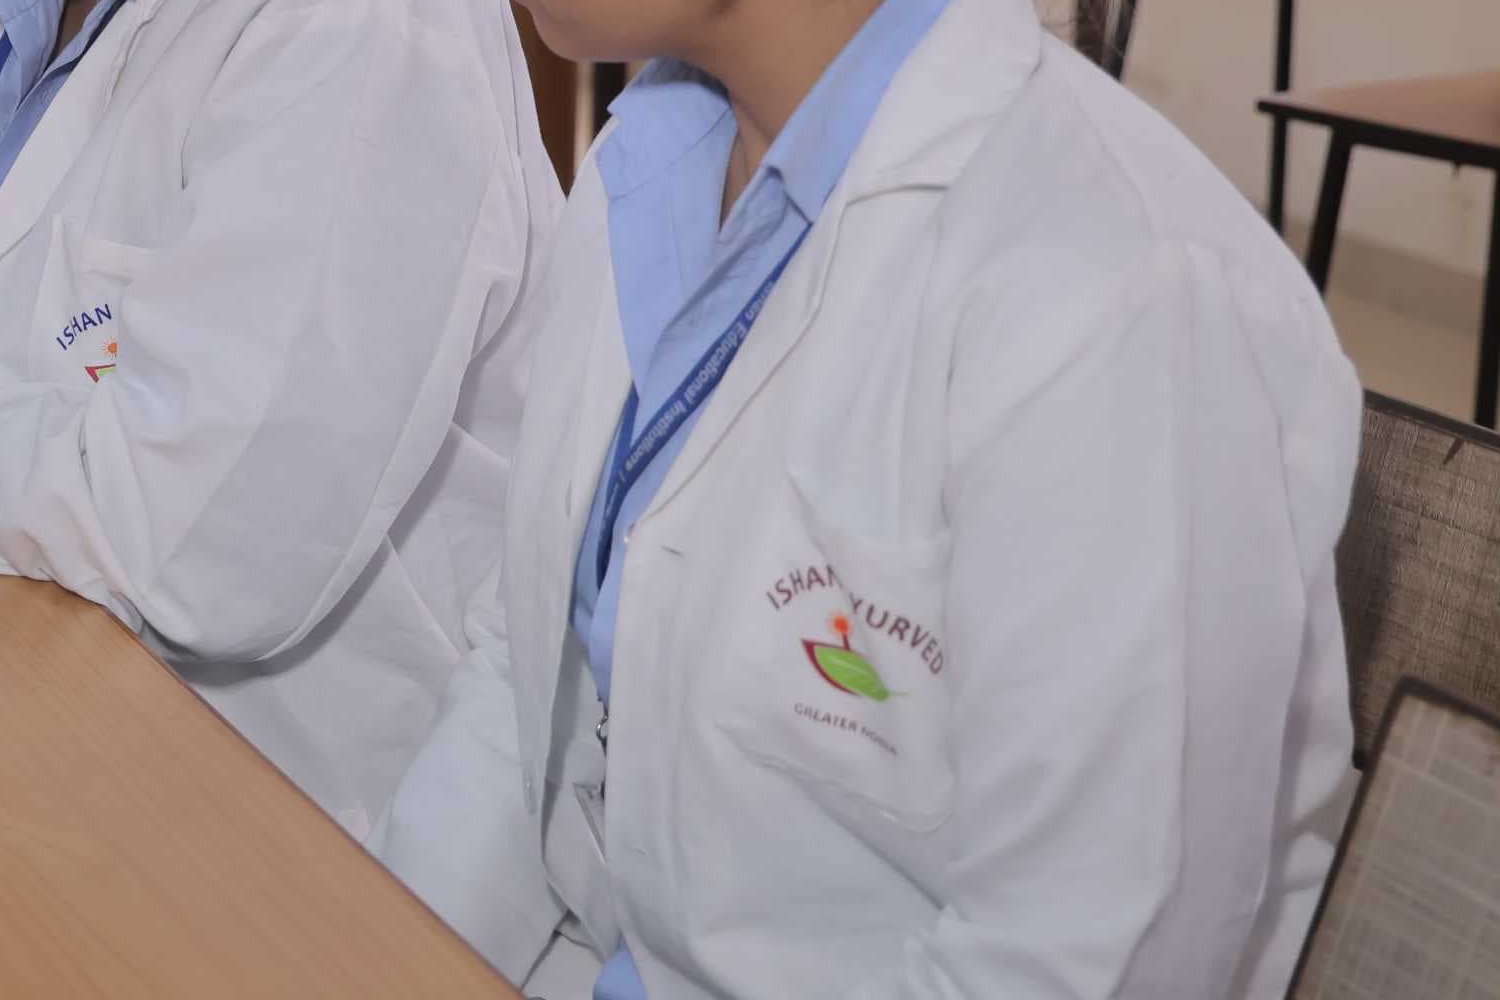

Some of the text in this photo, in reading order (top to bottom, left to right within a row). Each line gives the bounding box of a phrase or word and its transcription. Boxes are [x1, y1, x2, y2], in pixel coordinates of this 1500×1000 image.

[56, 304, 112, 350] ISHAN
[684, 321, 747, 405] Educational
[625, 401, 687, 472] Institutions
[849, 592, 944, 675] YURVED
